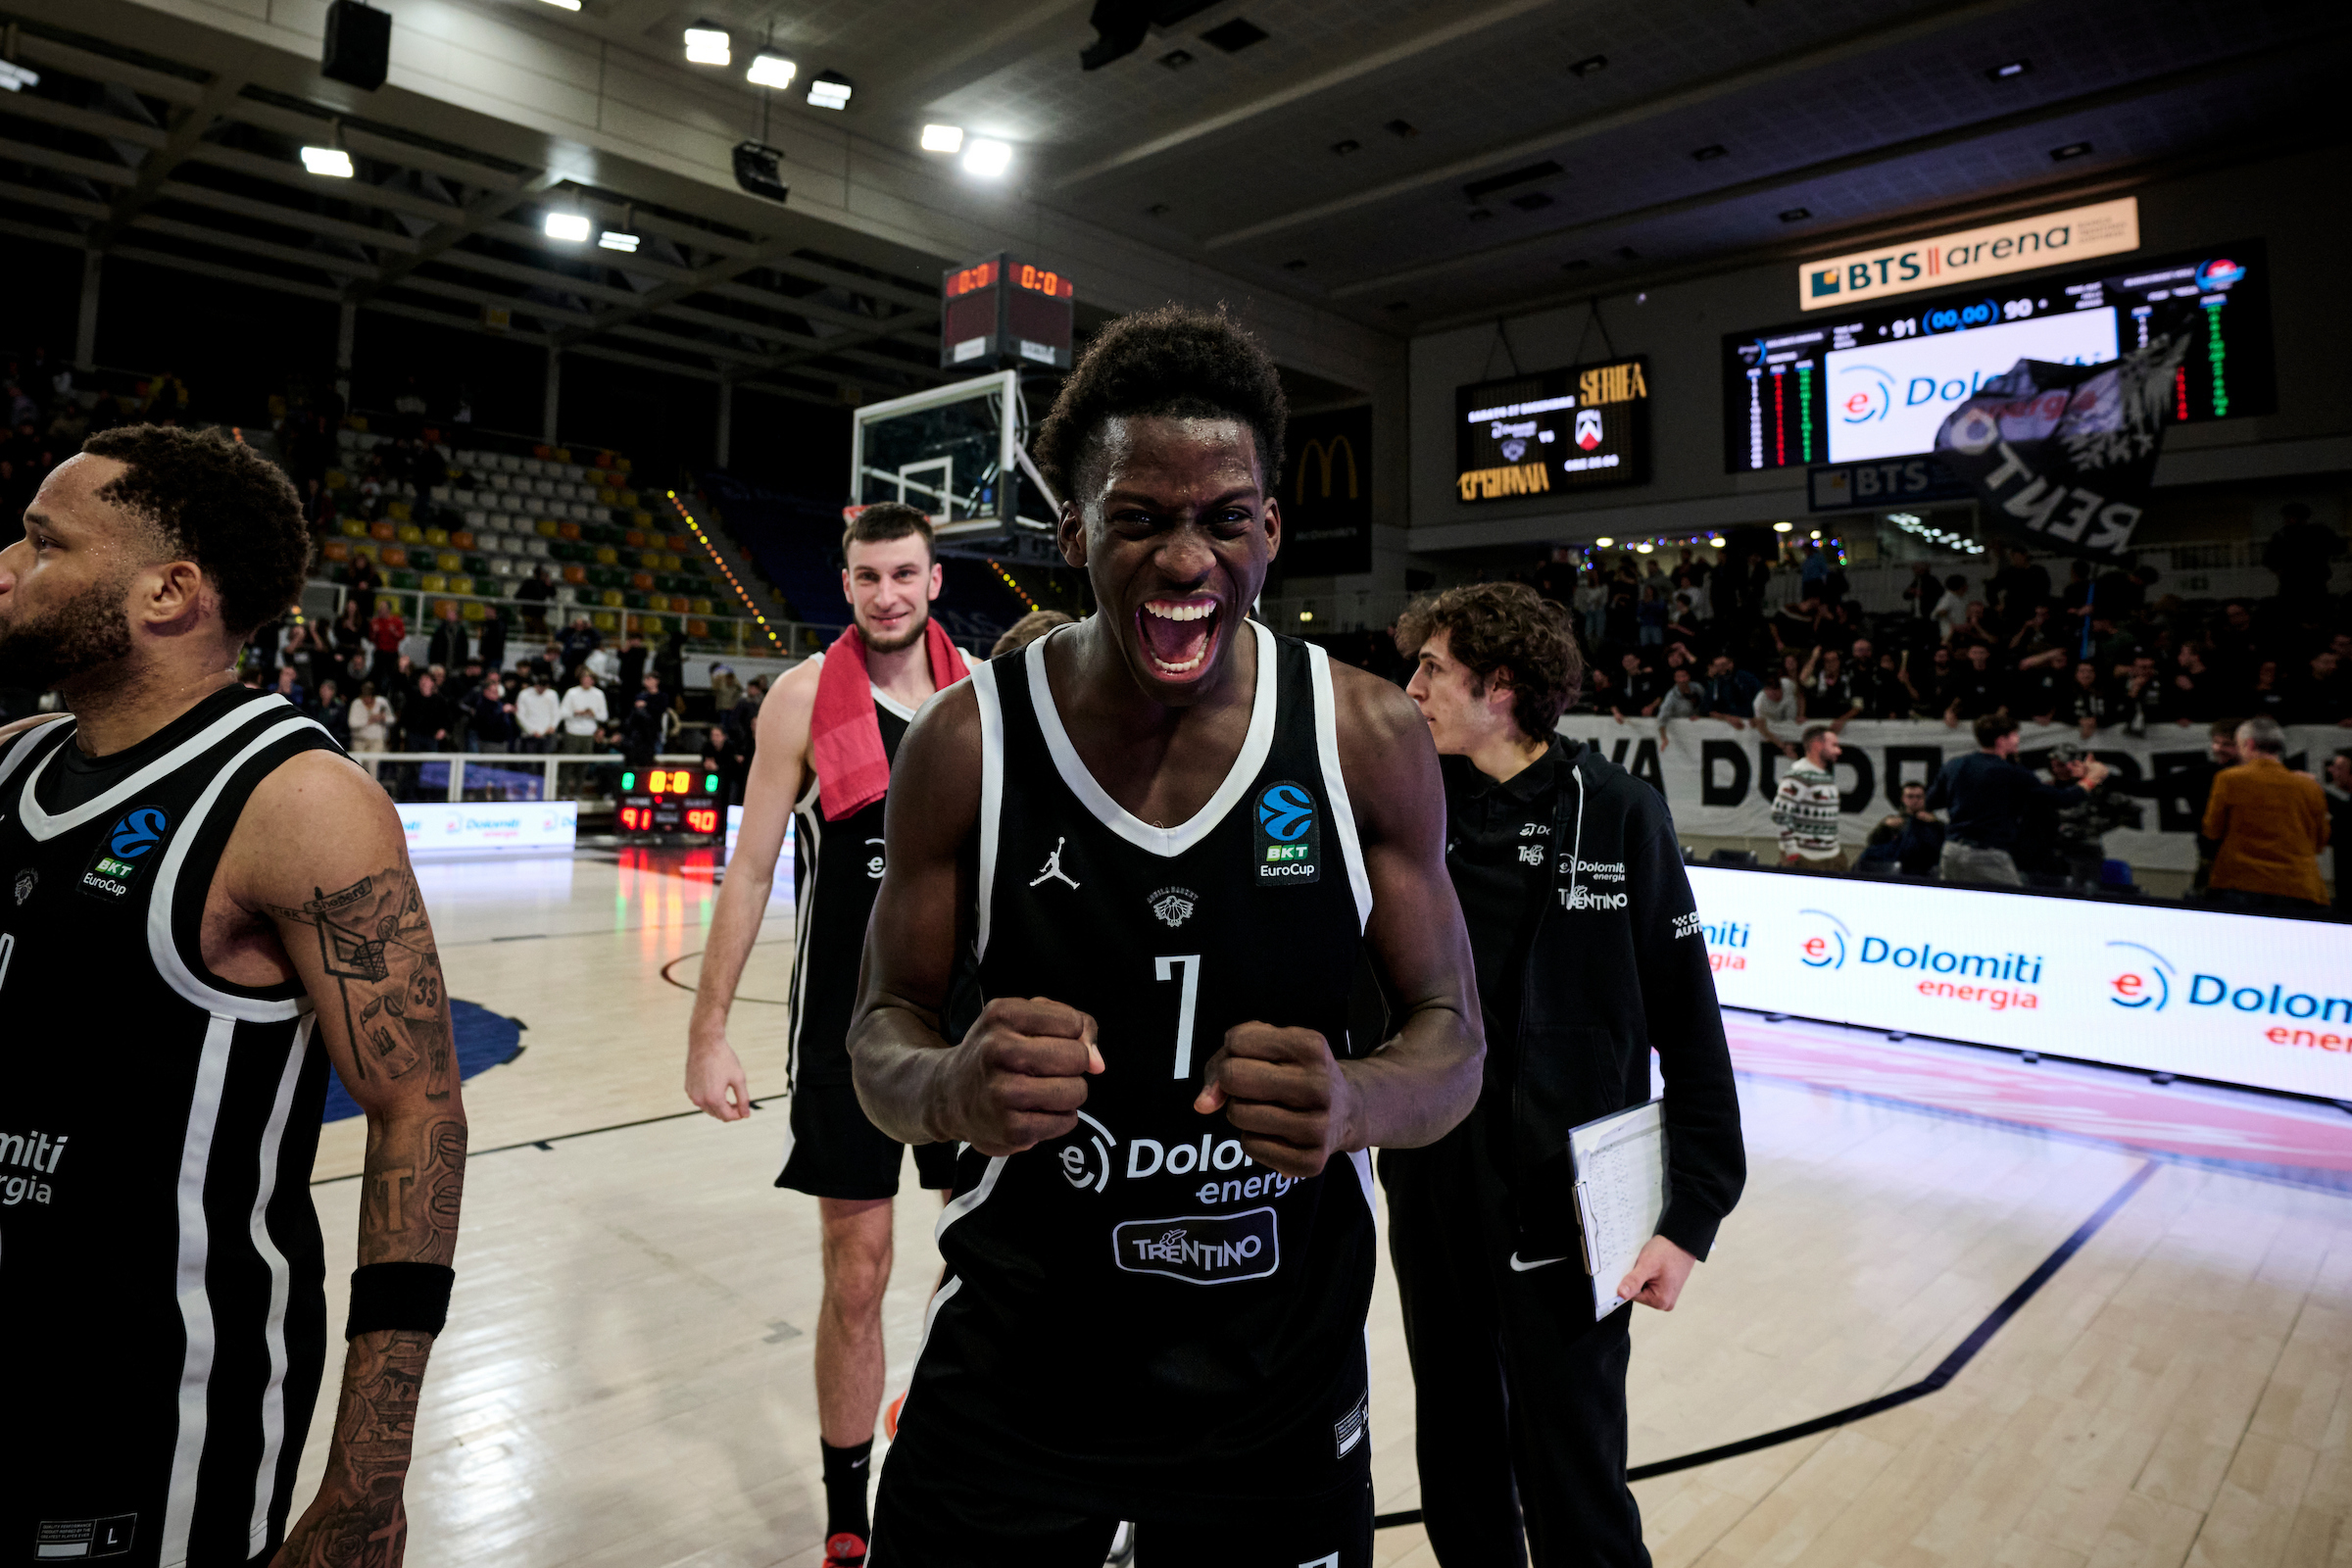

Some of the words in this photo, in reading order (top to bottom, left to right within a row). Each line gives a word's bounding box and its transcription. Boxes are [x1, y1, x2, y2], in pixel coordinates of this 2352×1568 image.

[1848, 252, 1922, 291] BTS
[1946, 224, 2071, 269] arena
[1020, 264, 1058, 296] 0:0
[2003, 298, 2034, 320] 90
[1891, 318, 1917, 339] 91
[1855, 461, 1930, 496] BTS
[621, 808, 652, 830] 91
[687, 809, 717, 833] 90
[1267, 846, 1308, 859] BKT
[97, 858, 132, 876] BKT
[1260, 863, 1315, 877] EuroCup
[82, 872, 127, 897] EuroCup
[1861, 937, 2043, 985] Dolomiti
[1916, 980, 2038, 1011] energia
[1154, 955, 1201, 1079] 7
[1133, 1235, 1262, 1271] TRENTINO
[107, 1528, 118, 1544] L
